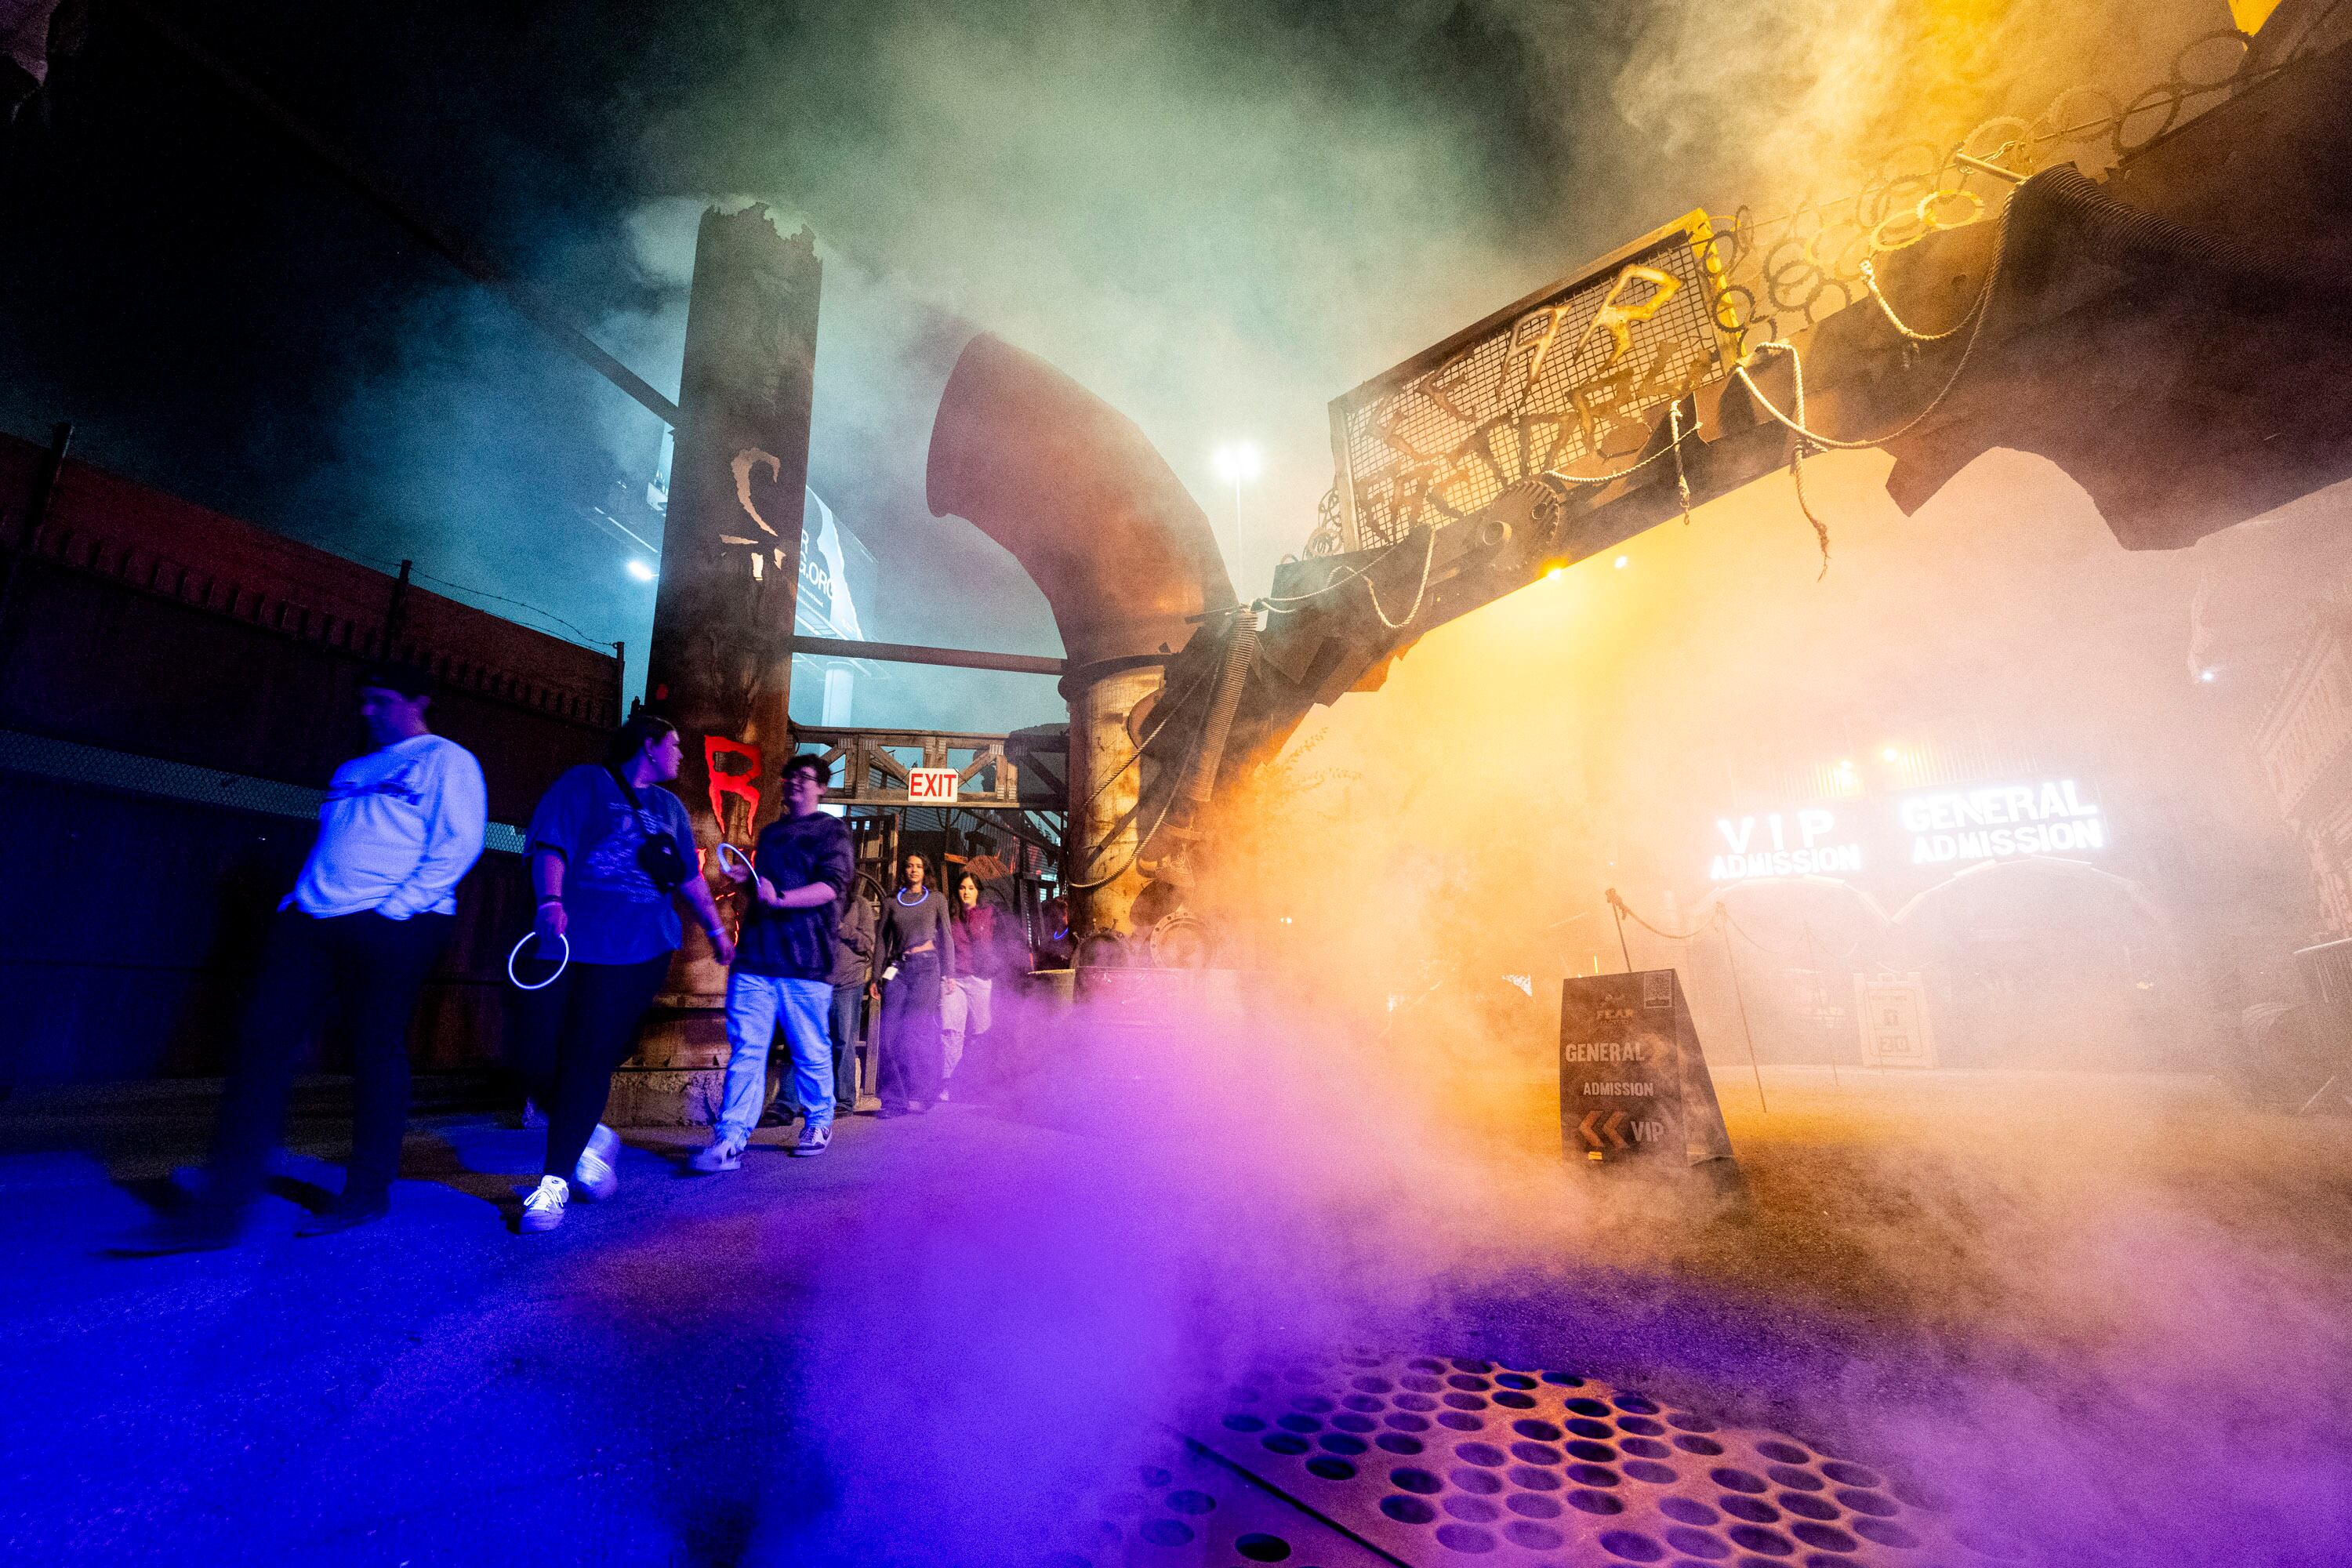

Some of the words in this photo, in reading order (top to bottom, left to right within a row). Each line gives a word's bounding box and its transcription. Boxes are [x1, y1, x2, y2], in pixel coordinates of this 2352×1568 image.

[910, 773, 956, 797] EXIT
[1900, 779, 2099, 833] GENERAL
[1717, 808, 1835, 855] VIP
[1911, 820, 2103, 865] ADMISSION
[1710, 843, 1860, 880] ADMISSION
[1565, 1042, 1645, 1062] GENERAL
[1583, 1082, 1654, 1096] ADMISSION
[1630, 1120, 1664, 1142] VIP
